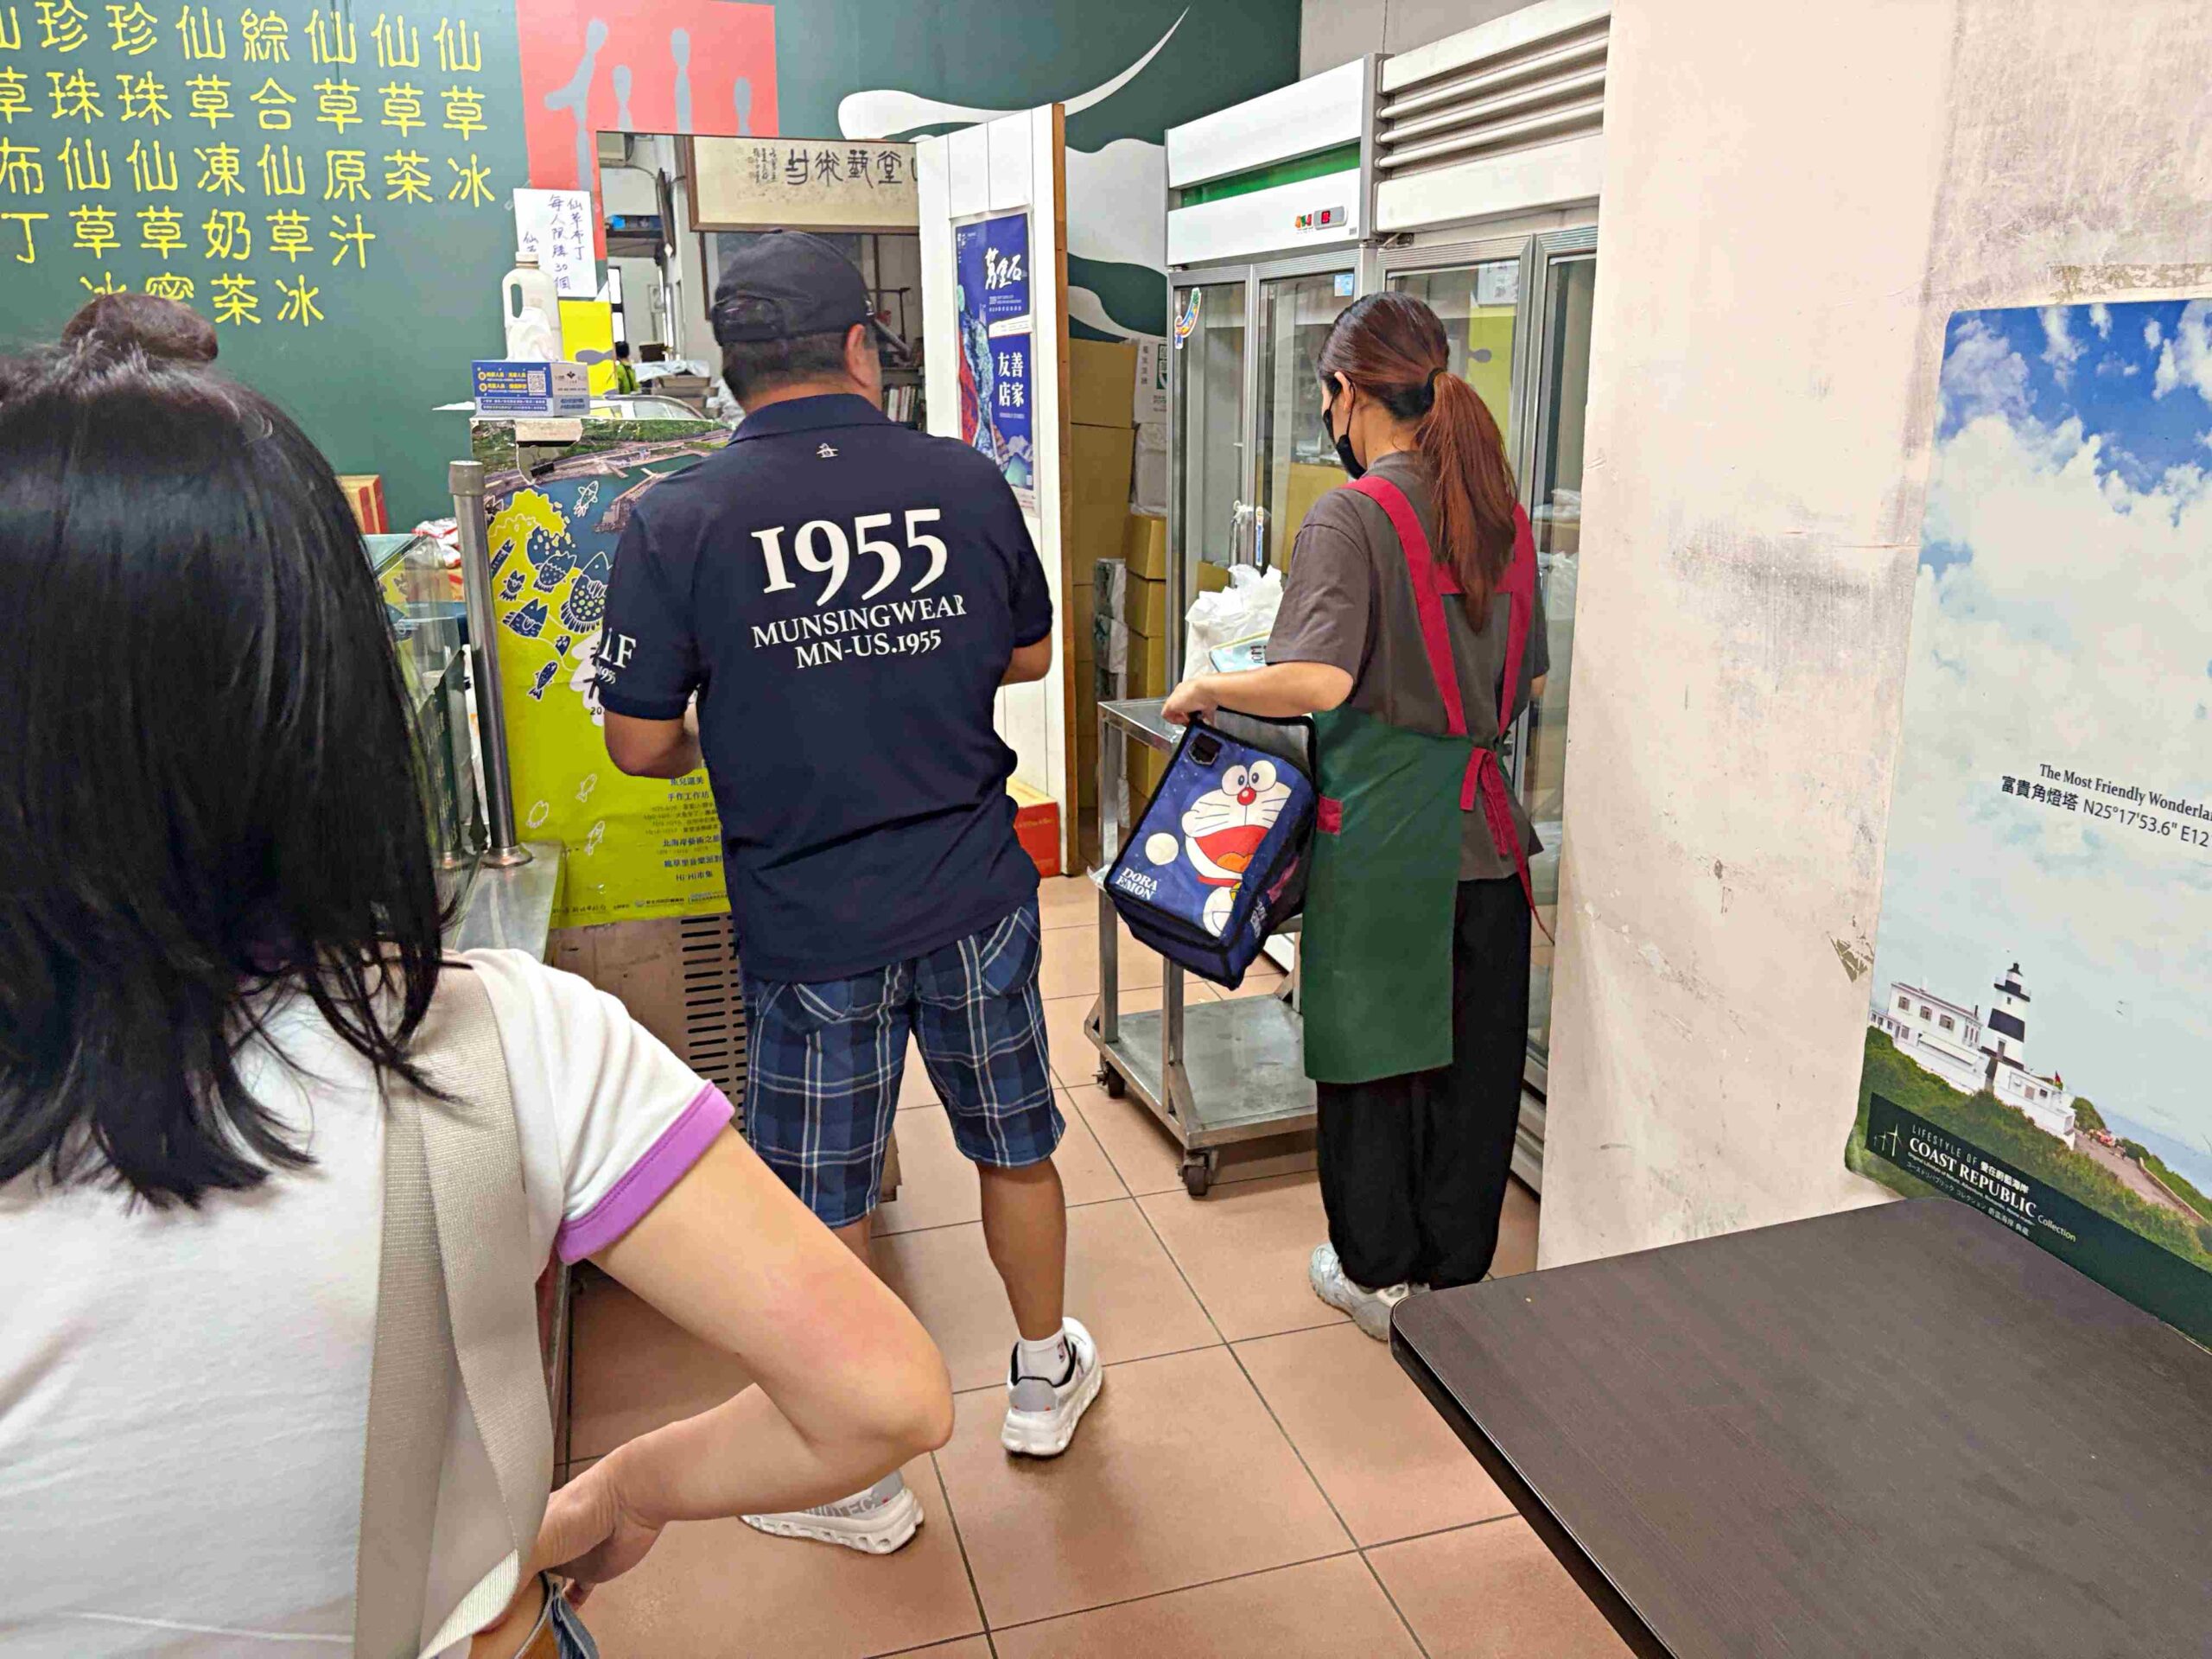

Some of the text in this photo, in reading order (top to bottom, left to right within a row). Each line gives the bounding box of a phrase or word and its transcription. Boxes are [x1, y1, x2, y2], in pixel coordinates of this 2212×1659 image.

[371, 13, 433, 204] 仙草茶
[434, 17, 495, 207] 仙草冰
[175, 5, 261, 326] 仙草凍奶茶
[304, 10, 376, 268] 仙草原汁
[241, 10, 324, 327] 綜合仙草冰
[997, 351, 1024, 378] 友善
[998, 381, 1026, 408] 店家
[751, 508, 948, 607] 1955
[751, 594, 967, 648] MUNSINGWEAR
[794, 629, 942, 669] MN-US.1955
[589, 706, 602, 715] 20
[2001, 775, 2079, 811] 富貴角燈塔
[2180, 825, 2212, 848] E12
[2040, 764, 2061, 781] The
[2063, 770, 2092, 790] Most
[2094, 778, 2146, 806] Friendly
[1116, 875, 1154, 900] EMON
[1122, 867, 1158, 892] DORA
[1911, 1124, 1961, 1157] LIFESTYLE
[1966, 1154, 1978, 1166] OF
[1910, 1137, 1957, 1173] COAST
[1959, 1164, 2037, 1218] REPUBLIC
[2037, 1214, 2076, 1243] Collection
